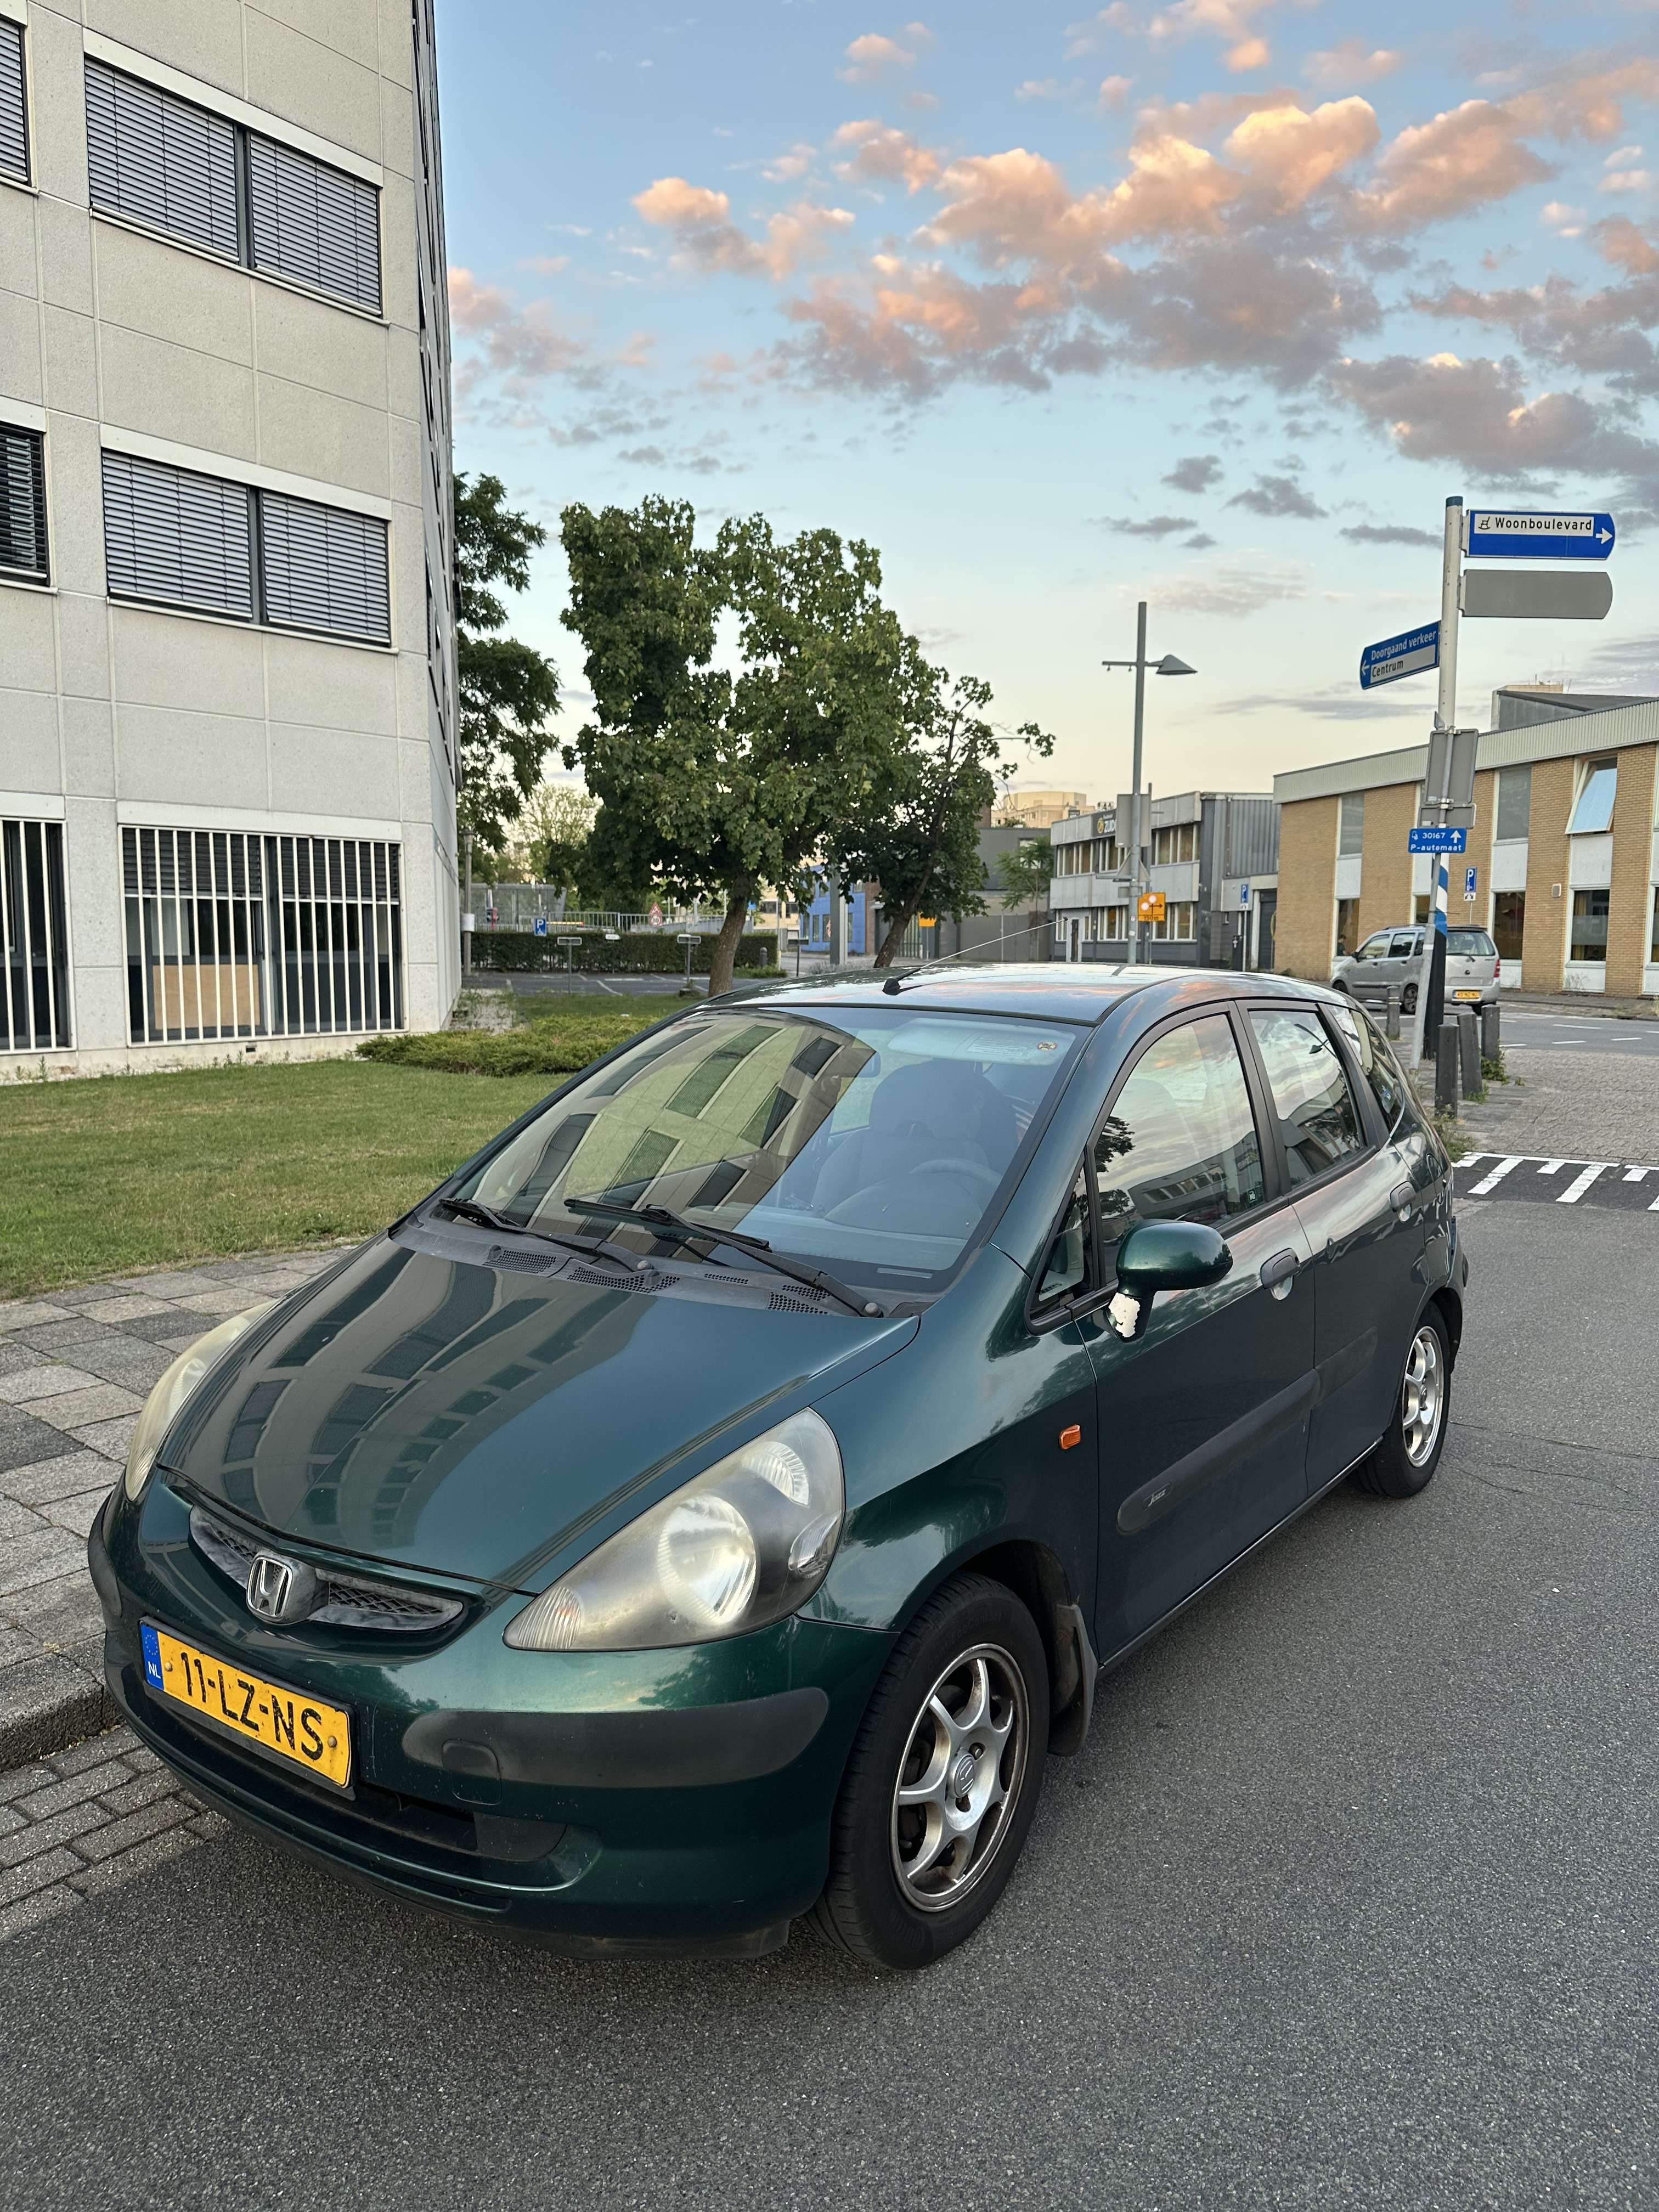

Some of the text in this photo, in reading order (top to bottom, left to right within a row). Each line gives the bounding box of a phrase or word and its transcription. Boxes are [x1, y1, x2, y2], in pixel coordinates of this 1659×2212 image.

[1495, 517, 1592, 531] Woonboulevard
[1371, 630, 1437, 661] Doorgaand verkeer
[1372, 660, 1404, 678] Centrum
[1467, 868, 1474, 882] P
[537, 919, 544, 928] P
[148, 1661, 161, 1679] NL
[180, 1652, 324, 1760] 11-LZ-NS
